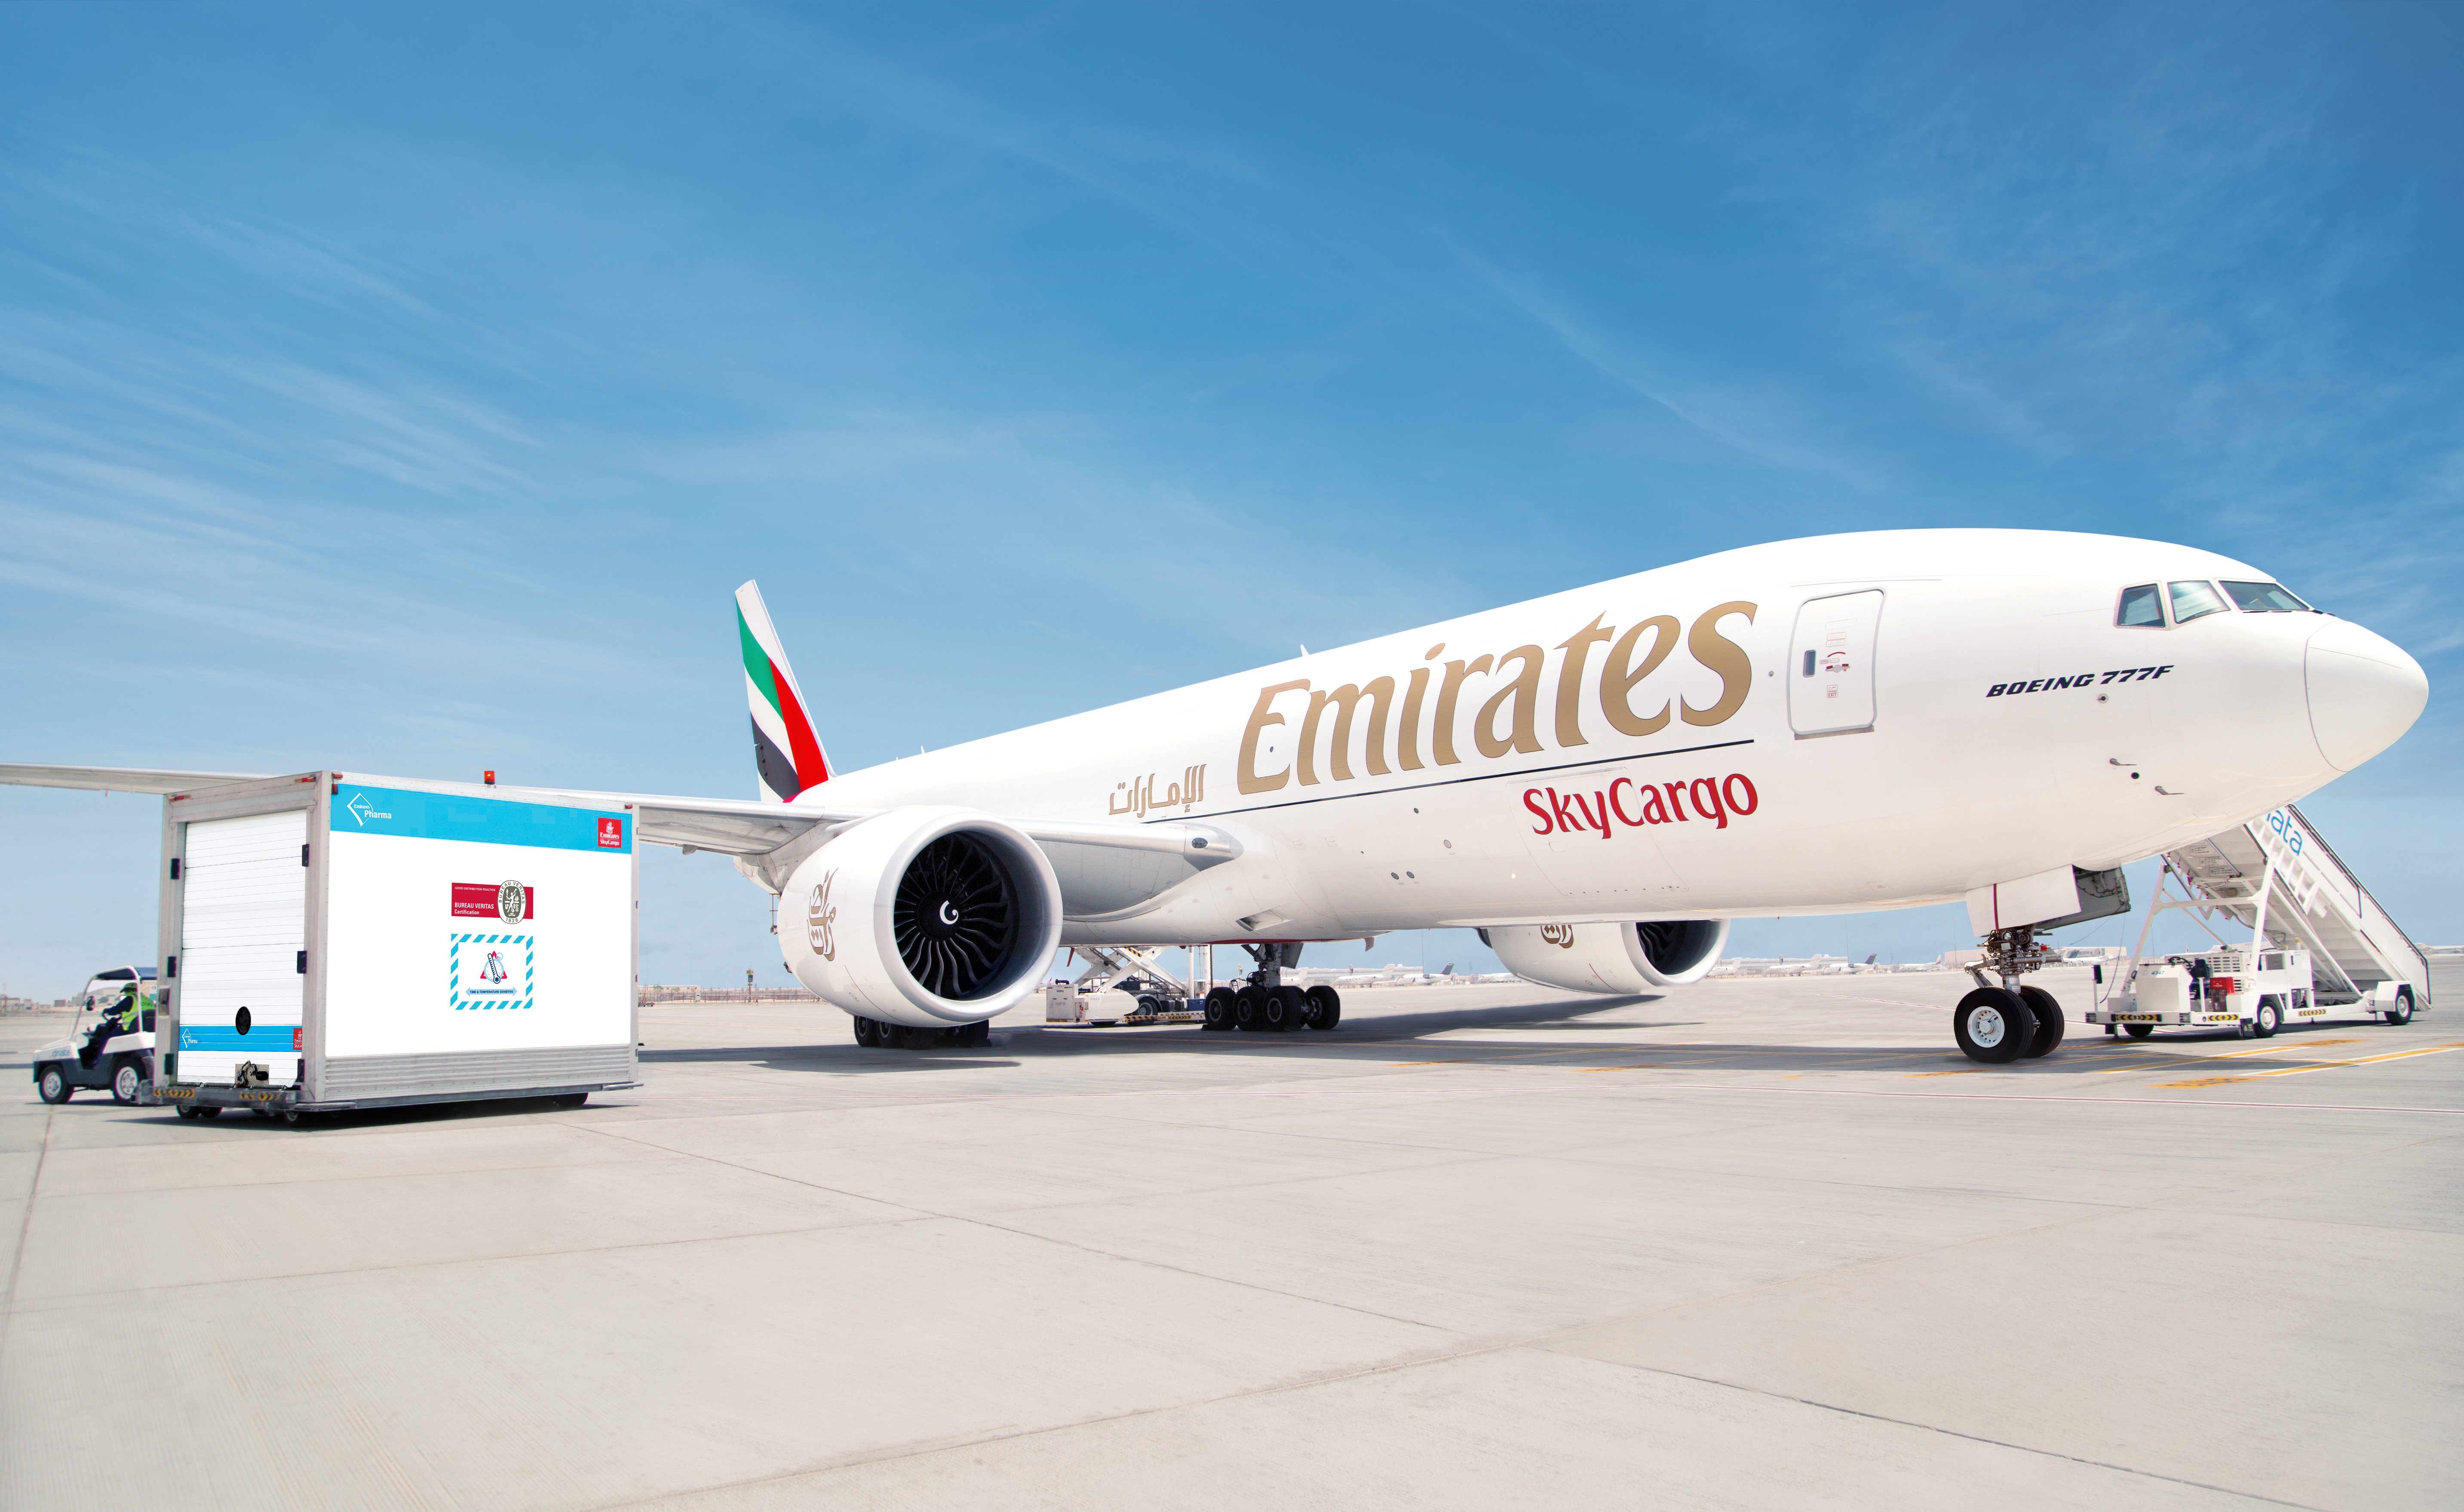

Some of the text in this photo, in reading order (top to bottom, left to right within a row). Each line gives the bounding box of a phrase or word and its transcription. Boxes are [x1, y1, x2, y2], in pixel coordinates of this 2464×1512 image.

[1237, 601, 1758, 795] Emirates
[1985, 665, 2175, 698] BOEING 777F
[1108, 764, 1207, 818] الإمارات
[1523, 773, 1758, 840] SkyCargo
[364, 810, 392, 819] Pharma
[2266, 810, 2302, 856] ata
[498, 881, 525, 904] BUREAU VERITAS
